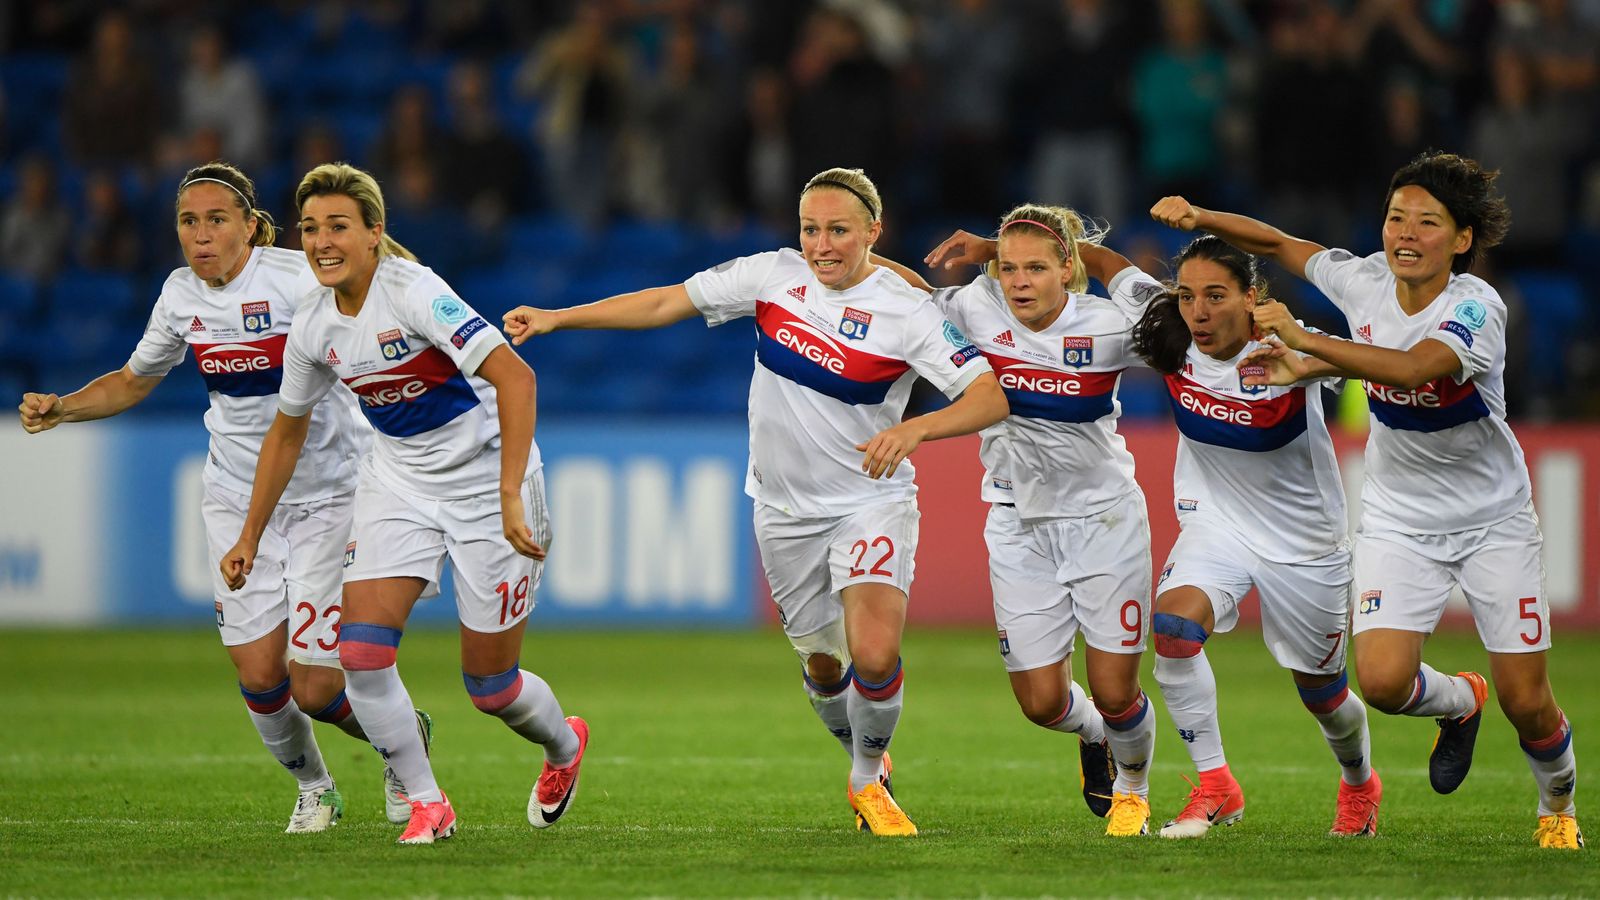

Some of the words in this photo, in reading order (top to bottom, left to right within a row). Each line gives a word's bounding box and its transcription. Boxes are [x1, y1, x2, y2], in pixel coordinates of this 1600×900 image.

[243, 302, 268, 310] OLYMPIQUE
[846, 308, 871, 319] OLYMPIQUE
[993, 337, 1015, 348] adidas
[849, 536, 894, 578] 22
[495, 575, 529, 625] 18
[291, 601, 341, 651] 23
[1120, 599, 1142, 646] 9
[1519, 597, 1542, 646] 5
[1317, 631, 1342, 669] 7
